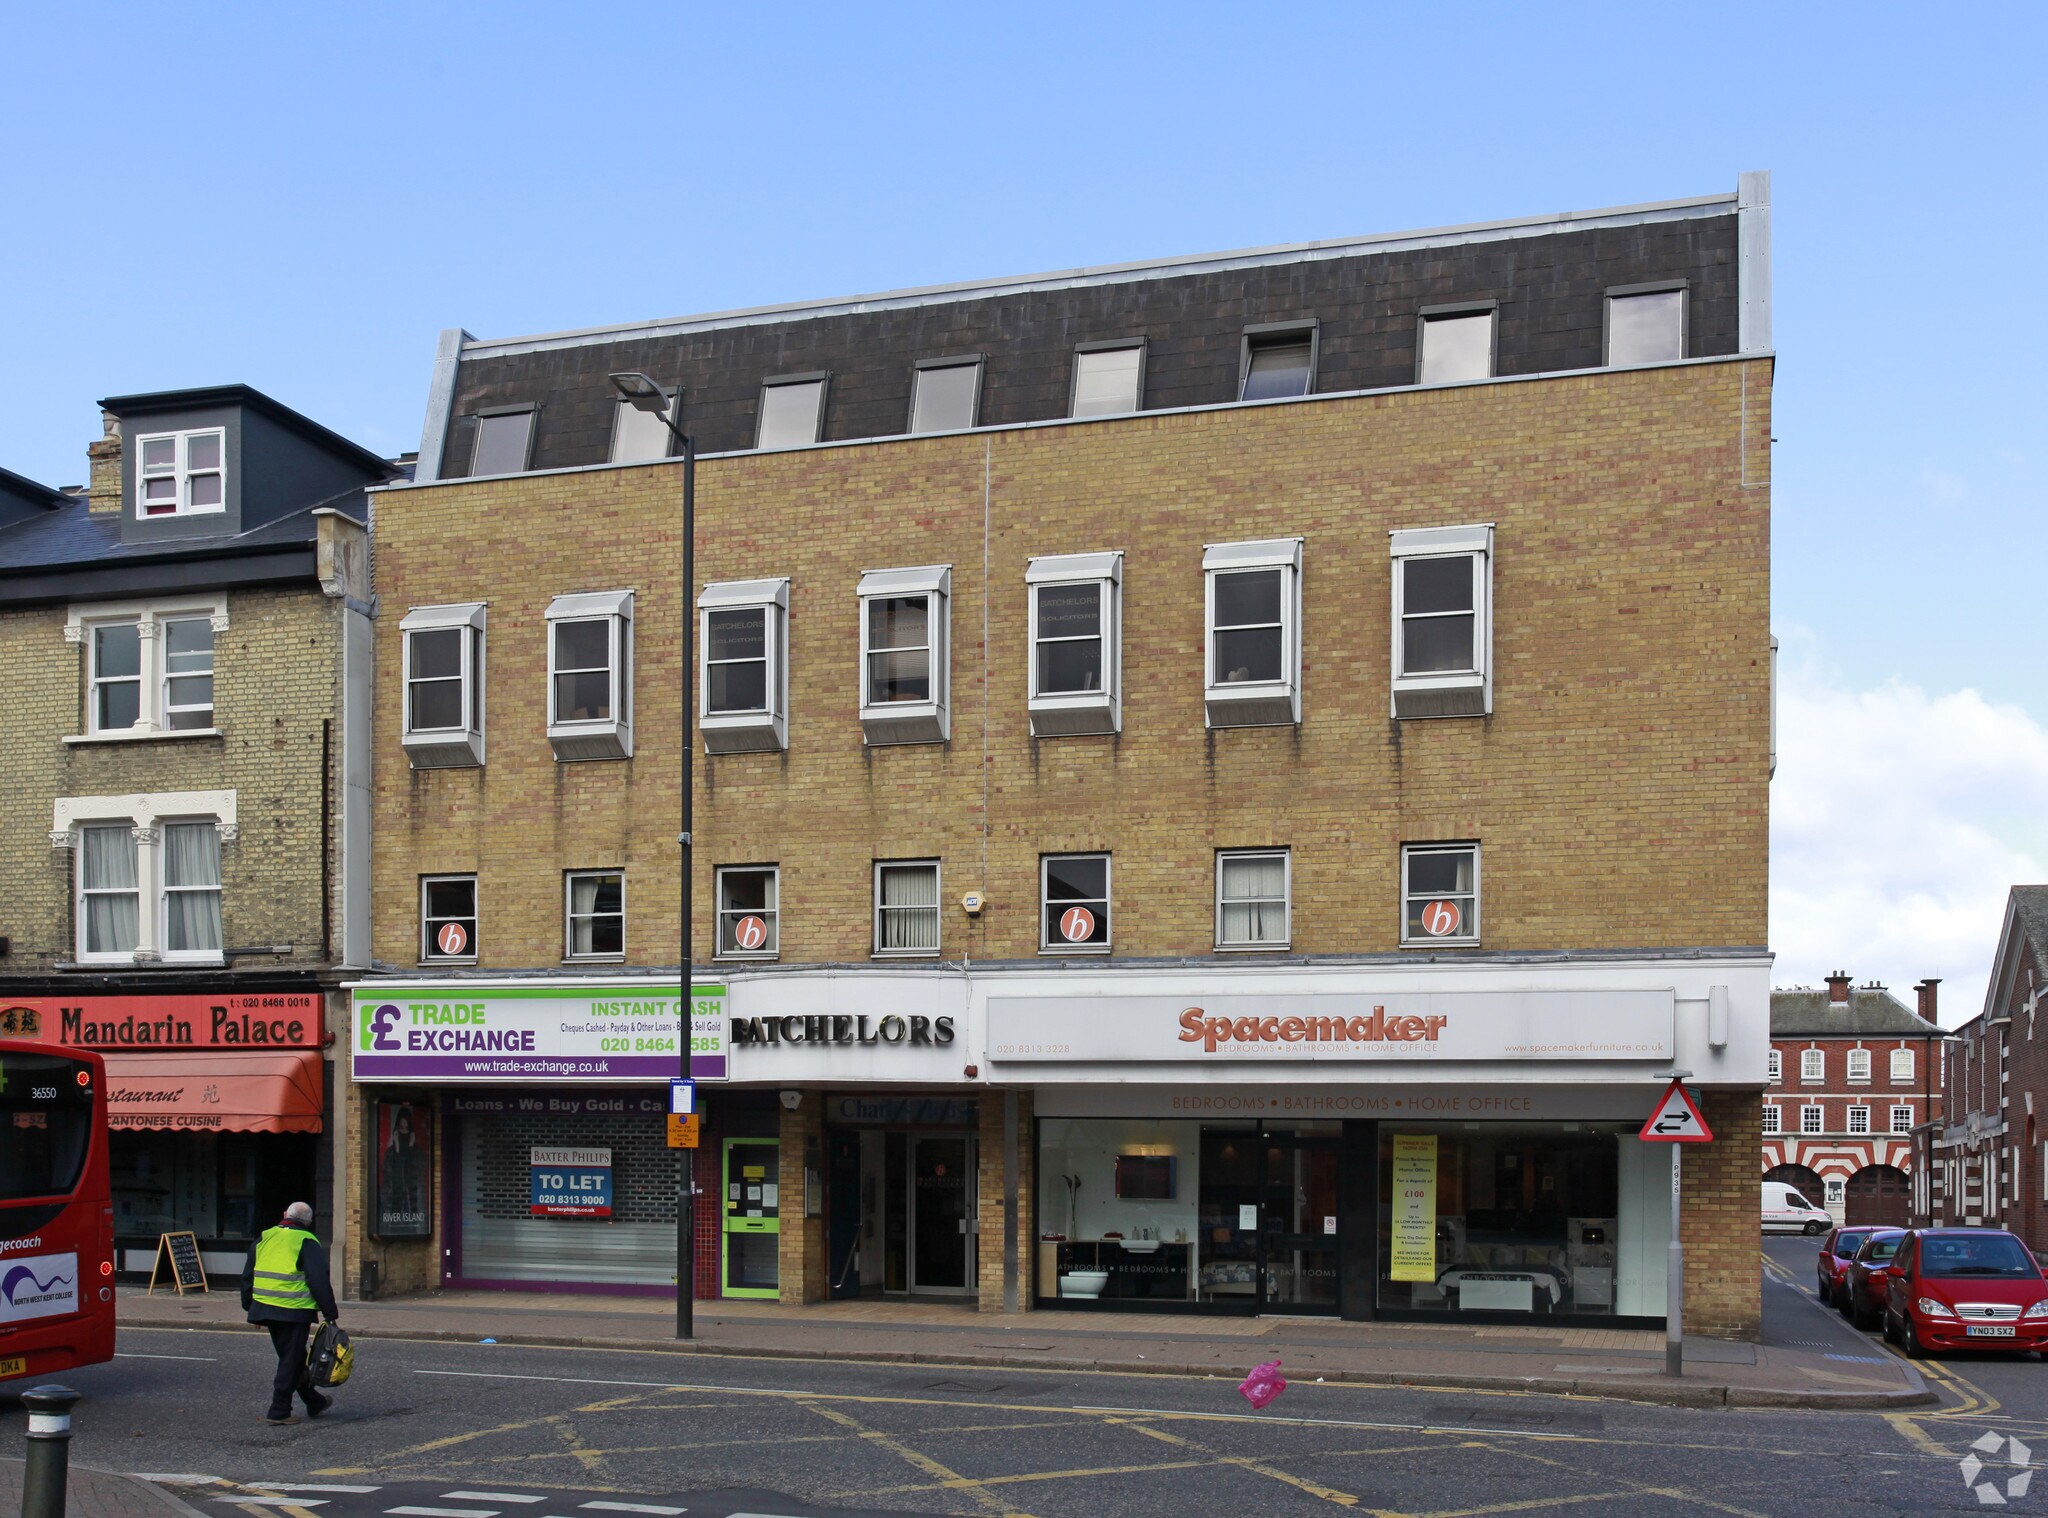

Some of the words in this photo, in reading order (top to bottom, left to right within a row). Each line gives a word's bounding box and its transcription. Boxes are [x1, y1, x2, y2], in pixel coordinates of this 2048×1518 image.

[1041, 596, 1099, 608] BATCHELORS
[1041, 613, 1098, 622] SOLICITORS
[711, 620, 764, 632] BATCHELORS
[242, 998, 259, 1008] 020
[591, 1001, 667, 1016] INSTANT
[408, 1004, 486, 1025] TRADE
[60, 1007, 192, 1045] Mandarin
[210, 1006, 304, 1044] Palace
[561, 1022, 585, 1035] Cheques
[586, 1022, 607, 1032] Cashed
[610, 1022, 629, 1034] Payday
[637, 1021, 654, 1031] Other
[655, 1021, 672, 1031] Loans
[695, 1021, 705, 1031] Sell
[707, 1021, 721, 1031] Gold
[729, 1014, 955, 1044] BATCHELORS
[1178, 1005, 1447, 1053] Spacemaker
[408, 1030, 535, 1052] EXCHANGE
[601, 1038, 630, 1051] 020
[635, 1038, 675, 1051] 8464
[690, 1037, 720, 1051] 585
[1217, 1044, 1275, 1053] BEDROOMS
[1286, 1044, 1350, 1053] BATHROOMS
[1363, 1043, 1395, 1052] HOME
[1399, 1043, 1438, 1052] OFFICE
[1503, 1042, 1664, 1053] www.spacemakerfurniture.co.uk
[997, 1045, 1015, 1054] 020
[1018, 1045, 1043, 1054] 8313
[1046, 1045, 1070, 1054] 3228
[464, 1060, 609, 1074] www.trade-exchange.co.uk
[32, 1087, 57, 1099] 36550
[106, 1088, 184, 1103] staurant
[455, 1099, 503, 1111] Loans
[519, 1099, 543, 1111] We
[550, 1099, 580, 1113] Buy
[585, 1099, 623, 1111] Gold
[1173, 1096, 1265, 1110] BEDROOMS
[1284, 1096, 1389, 1110] BATHROOMS
[1409, 1097, 1460, 1111] HOME
[1469, 1097, 1531, 1111] OFFICE
[177, 1116, 222, 1127] CUISINE
[534, 1151, 569, 1162] BAXTER
[572, 1151, 609, 1163] PHILIPS
[539, 1174, 564, 1190] TO
[569, 1175, 605, 1190] LET
[539, 1194, 556, 1204] 020
[558, 1195, 580, 1204] 8313
[581, 1196, 605, 1205] 9000
[1405, 1190, 1424, 1198] £100
[383, 1212, 401, 1223] RIVER
[403, 1212, 425, 1222] ISLAND
[0, 1236, 41, 1254] gecoach
[1057, 1264, 1107, 1273] ATHROOMS
[1119, 1265, 1169, 1274] BEDROOMS
[1280, 1268, 1337, 1278] BATROOMS
[14, 1296, 29, 1306] NORTH
[30, 1295, 42, 1304] WEST
[43, 1293, 55, 1302] KENT
[55, 1290, 73, 1300] COLLEGE
[1972, 1327, 1995, 1335] YN03
[1997, 1327, 2014, 1335] SXZ
[1, 1361, 20, 1374] DKA
